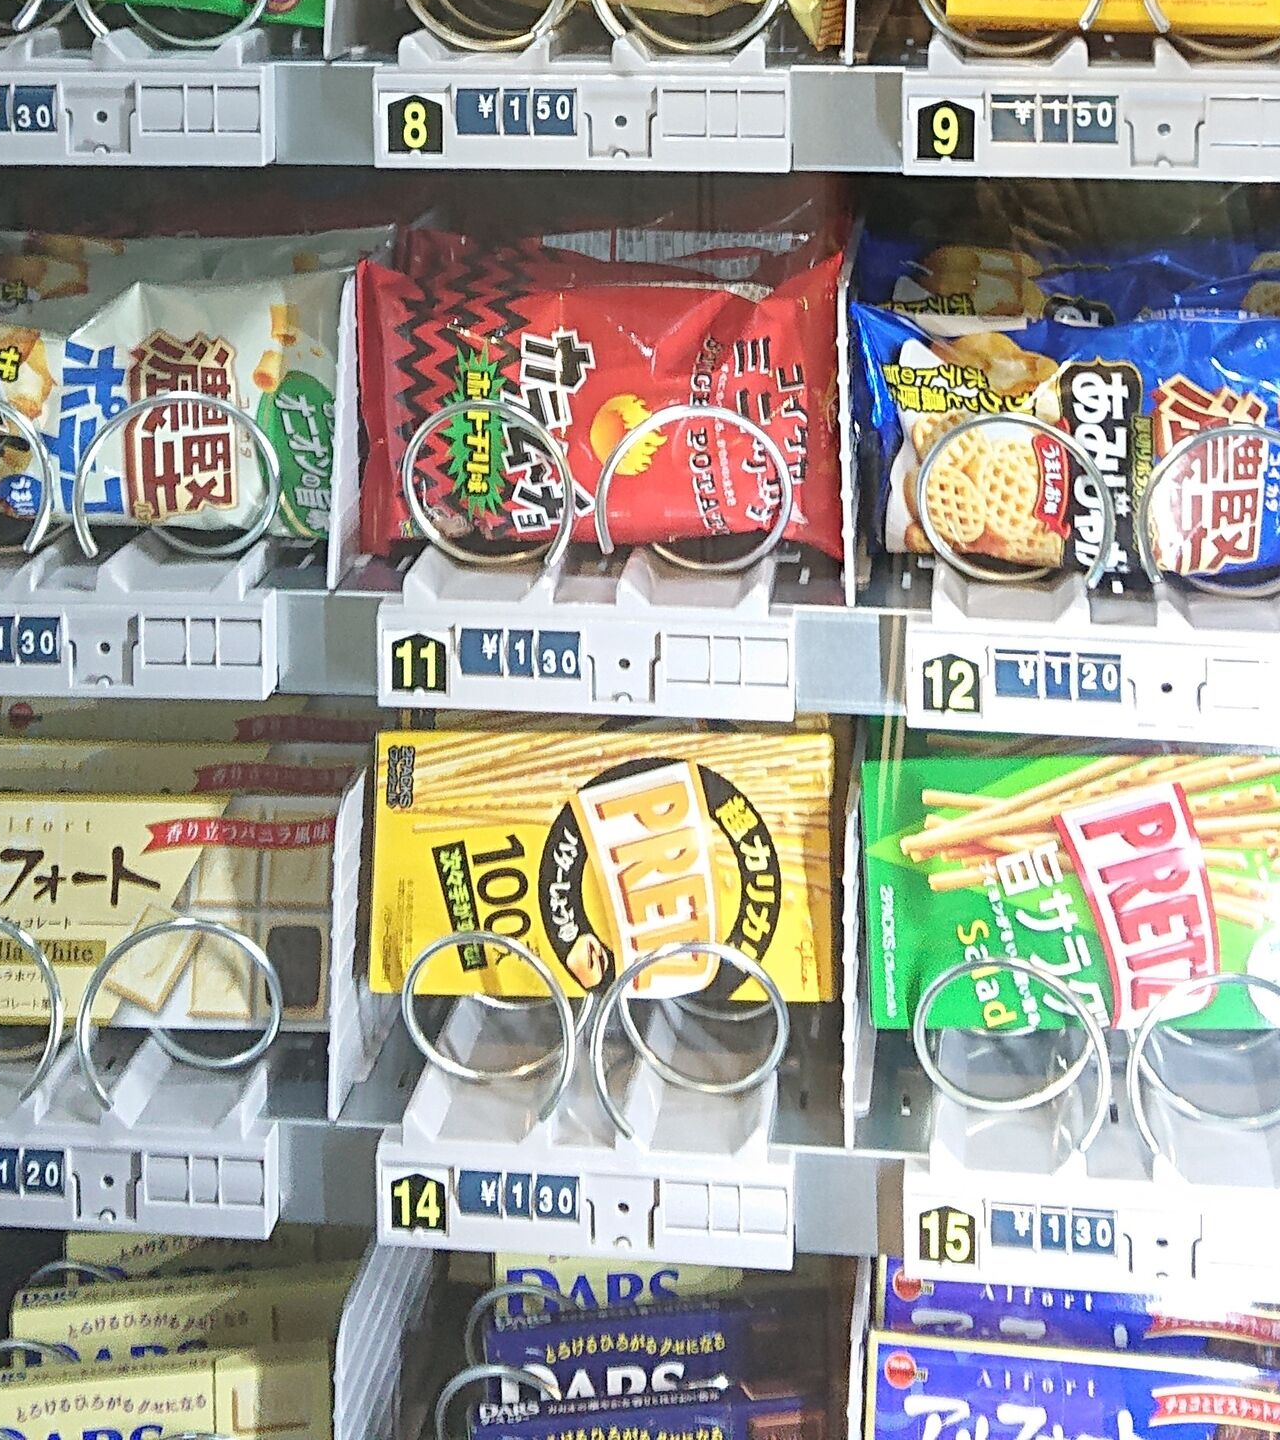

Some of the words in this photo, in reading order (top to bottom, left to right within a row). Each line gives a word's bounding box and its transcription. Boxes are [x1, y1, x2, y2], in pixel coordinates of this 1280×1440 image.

[403, 102, 429, 149] 8
[478, 94, 571, 121] ¥150
[932, 106, 960, 155] 9
[465, 369, 492, 496] ホトチリ味
[396, 645, 440, 690] 11
[483, 633, 576, 674] ¥130
[926, 662, 976, 709] 12
[1019, 652, 1118, 691] ¥120
[32, 940, 95, 964] hite
[393, 1181, 441, 1227] 14
[480, 1180, 573, 1214] ¥130
[922, 1212, 970, 1262] 15
[1014, 1210, 1113, 1247] ¥130
